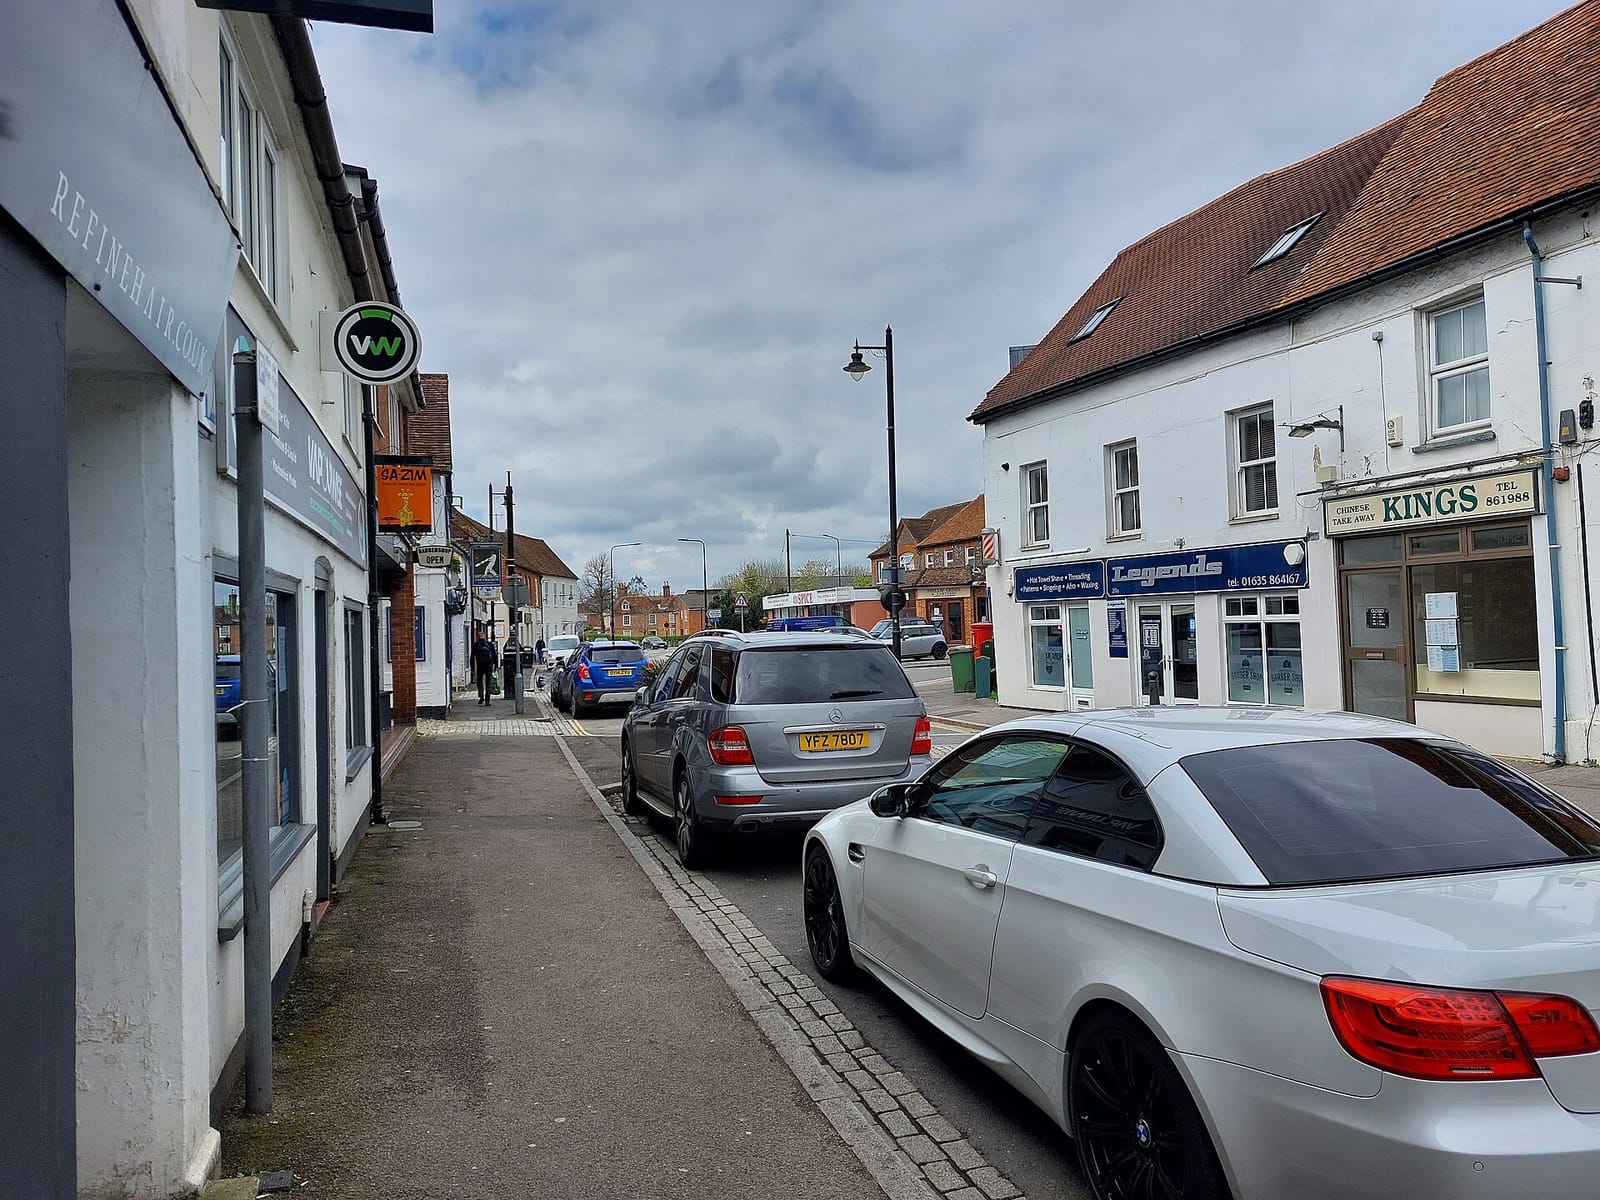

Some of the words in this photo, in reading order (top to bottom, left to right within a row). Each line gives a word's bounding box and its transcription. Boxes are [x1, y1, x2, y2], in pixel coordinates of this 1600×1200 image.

[380, 468, 427, 481] SA-ZIM
[1496, 481, 1518, 492] TEL
[1382, 484, 1479, 522] KINGS
[1485, 491, 1530, 507] 861988
[1336, 503, 1370, 515] CHINESE
[1332, 515, 1352, 526] TAKE
[1354, 513, 1376, 524] AWAY
[426, 556, 444, 564] OPEN
[1068, 573, 1091, 581] Threading
[1112, 554, 1223, 587] Legends
[1080, 581, 1099, 590] Waxing
[1227, 577, 1240, 587] tel:
[1241, 575, 1267, 586] 01635
[1269, 573, 1300, 585] 864167
[805, 735, 829, 748] YFZ
[833, 733, 864, 746] 7807
